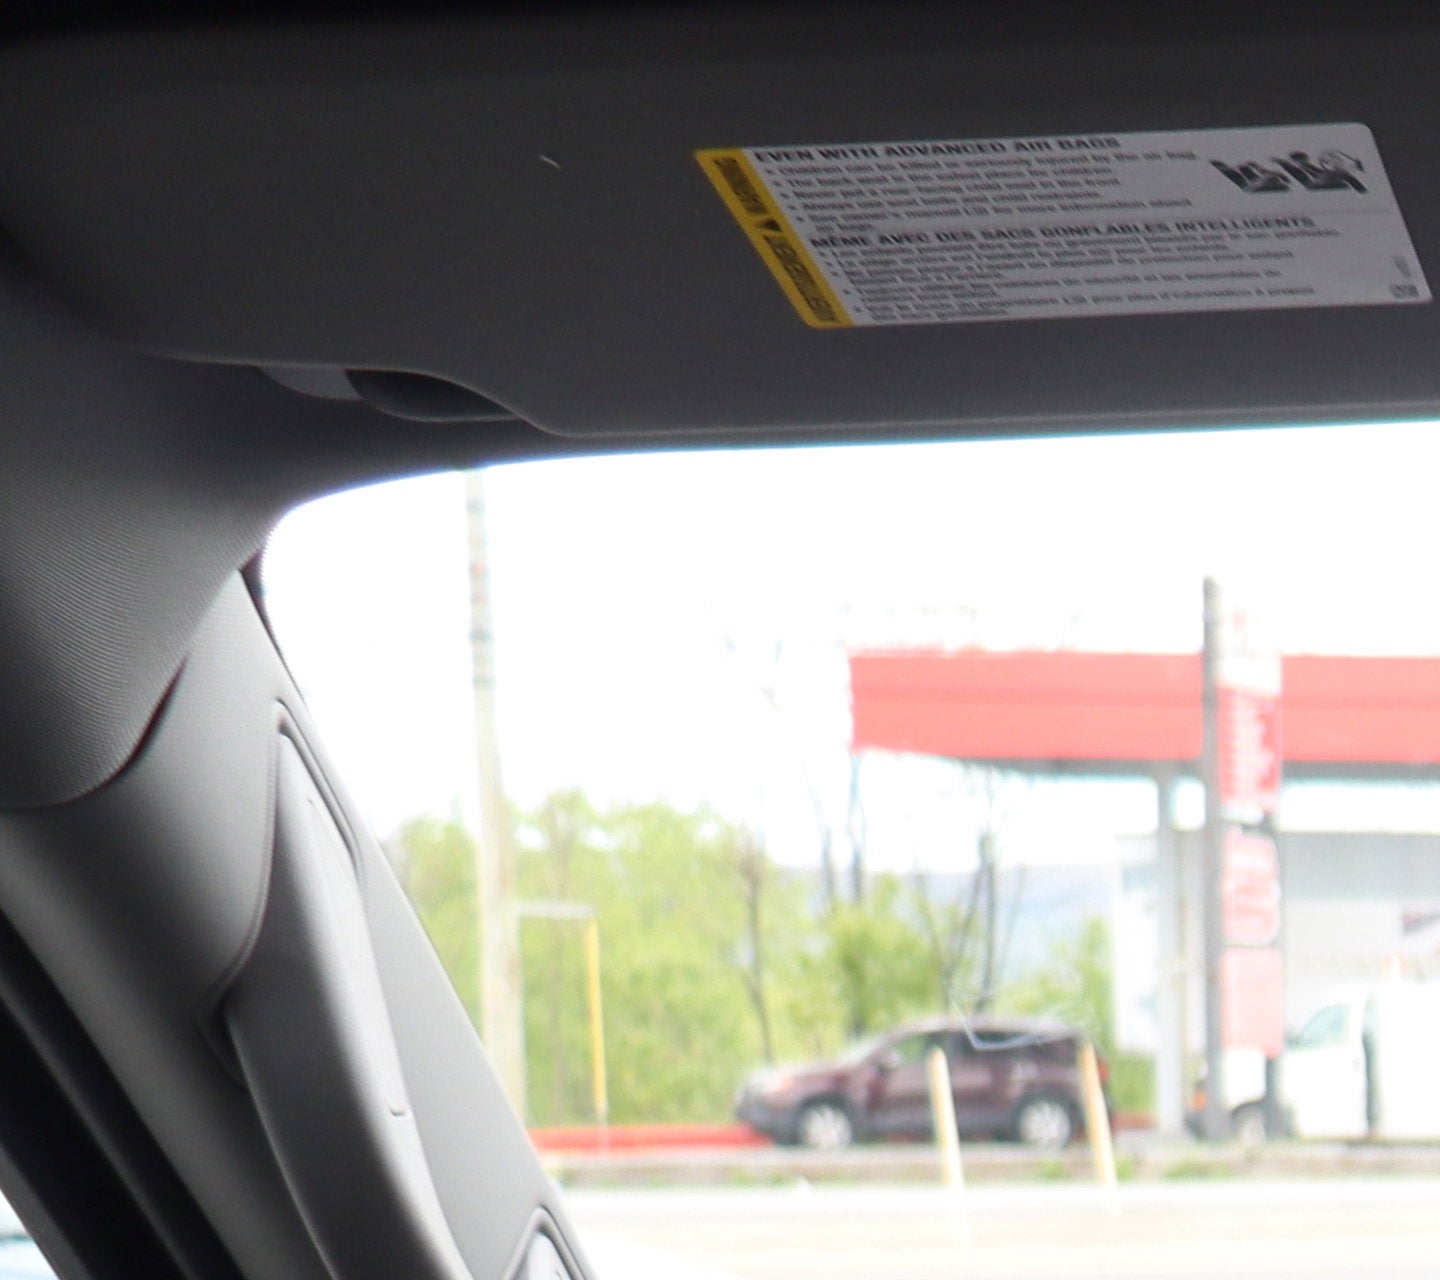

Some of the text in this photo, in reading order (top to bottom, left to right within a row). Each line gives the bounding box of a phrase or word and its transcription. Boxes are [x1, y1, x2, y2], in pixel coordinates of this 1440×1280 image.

[754, 137, 1121, 162] EVEN WITH ADVANCED AIR BAGS
